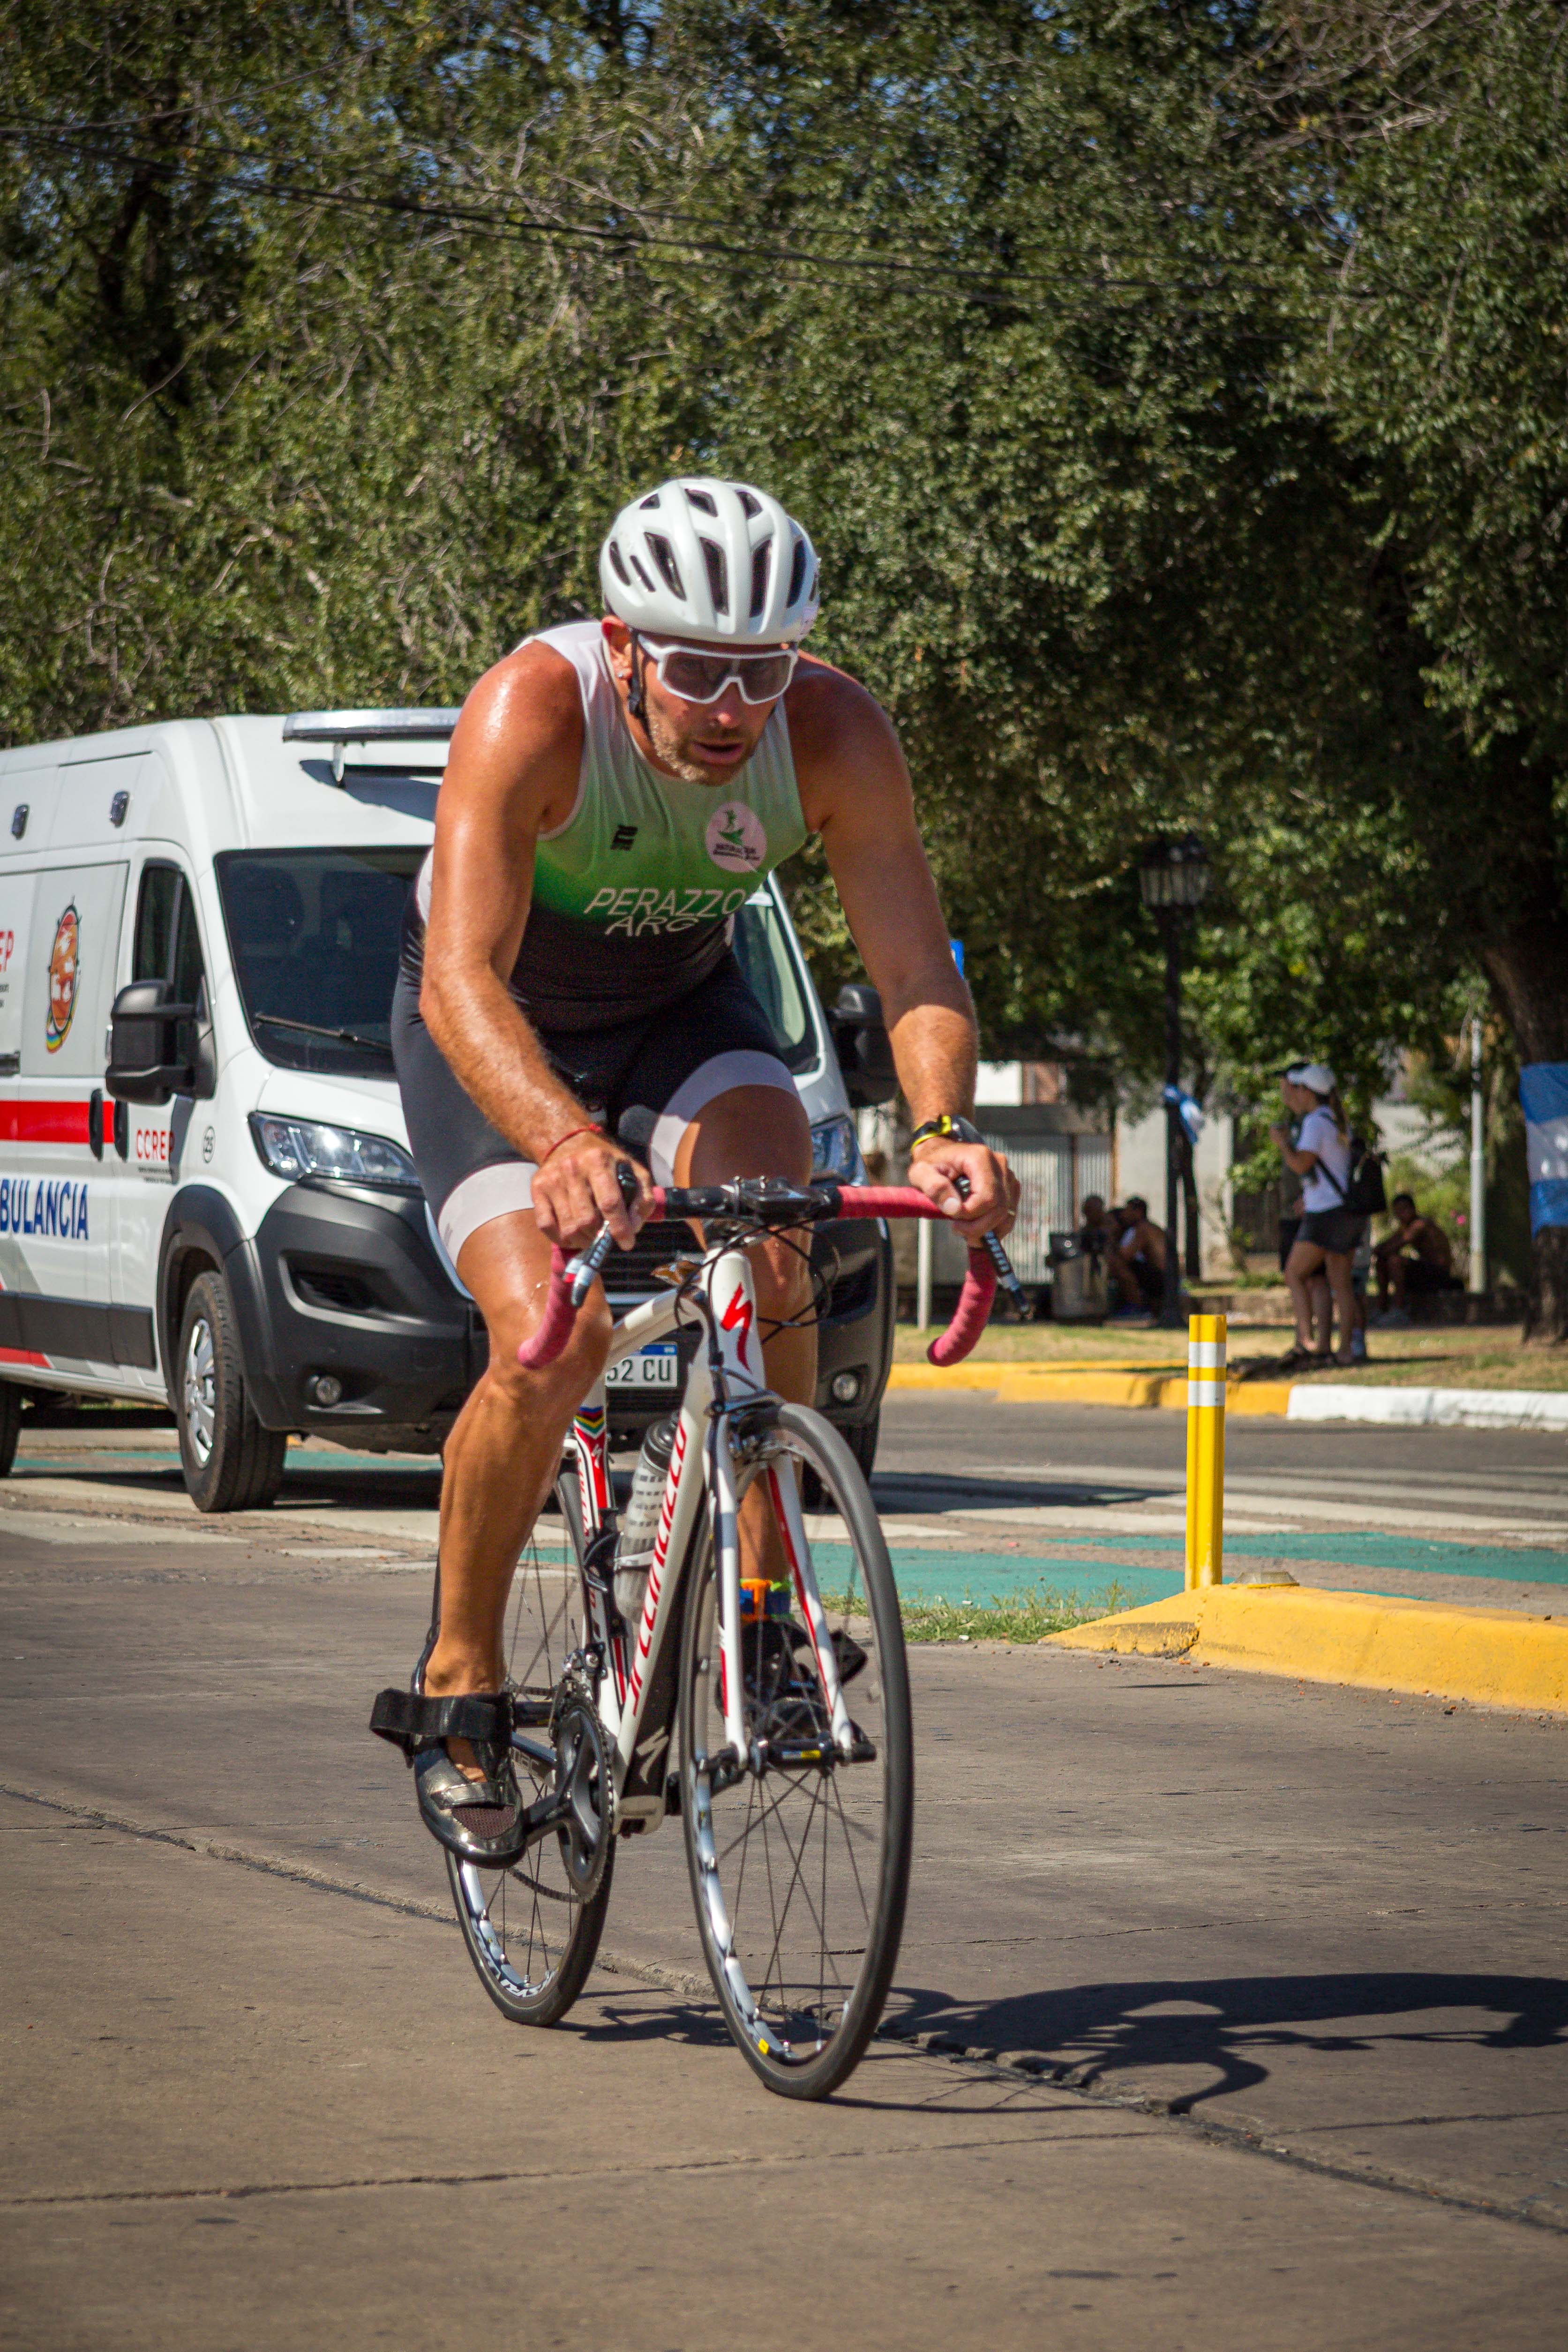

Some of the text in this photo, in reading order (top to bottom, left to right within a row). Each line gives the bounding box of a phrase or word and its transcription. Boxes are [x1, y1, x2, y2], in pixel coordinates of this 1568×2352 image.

[584, 887, 747, 916] PERAZZO
[604, 915, 699, 937] ARG
[643, 1359, 670, 1381] CU
